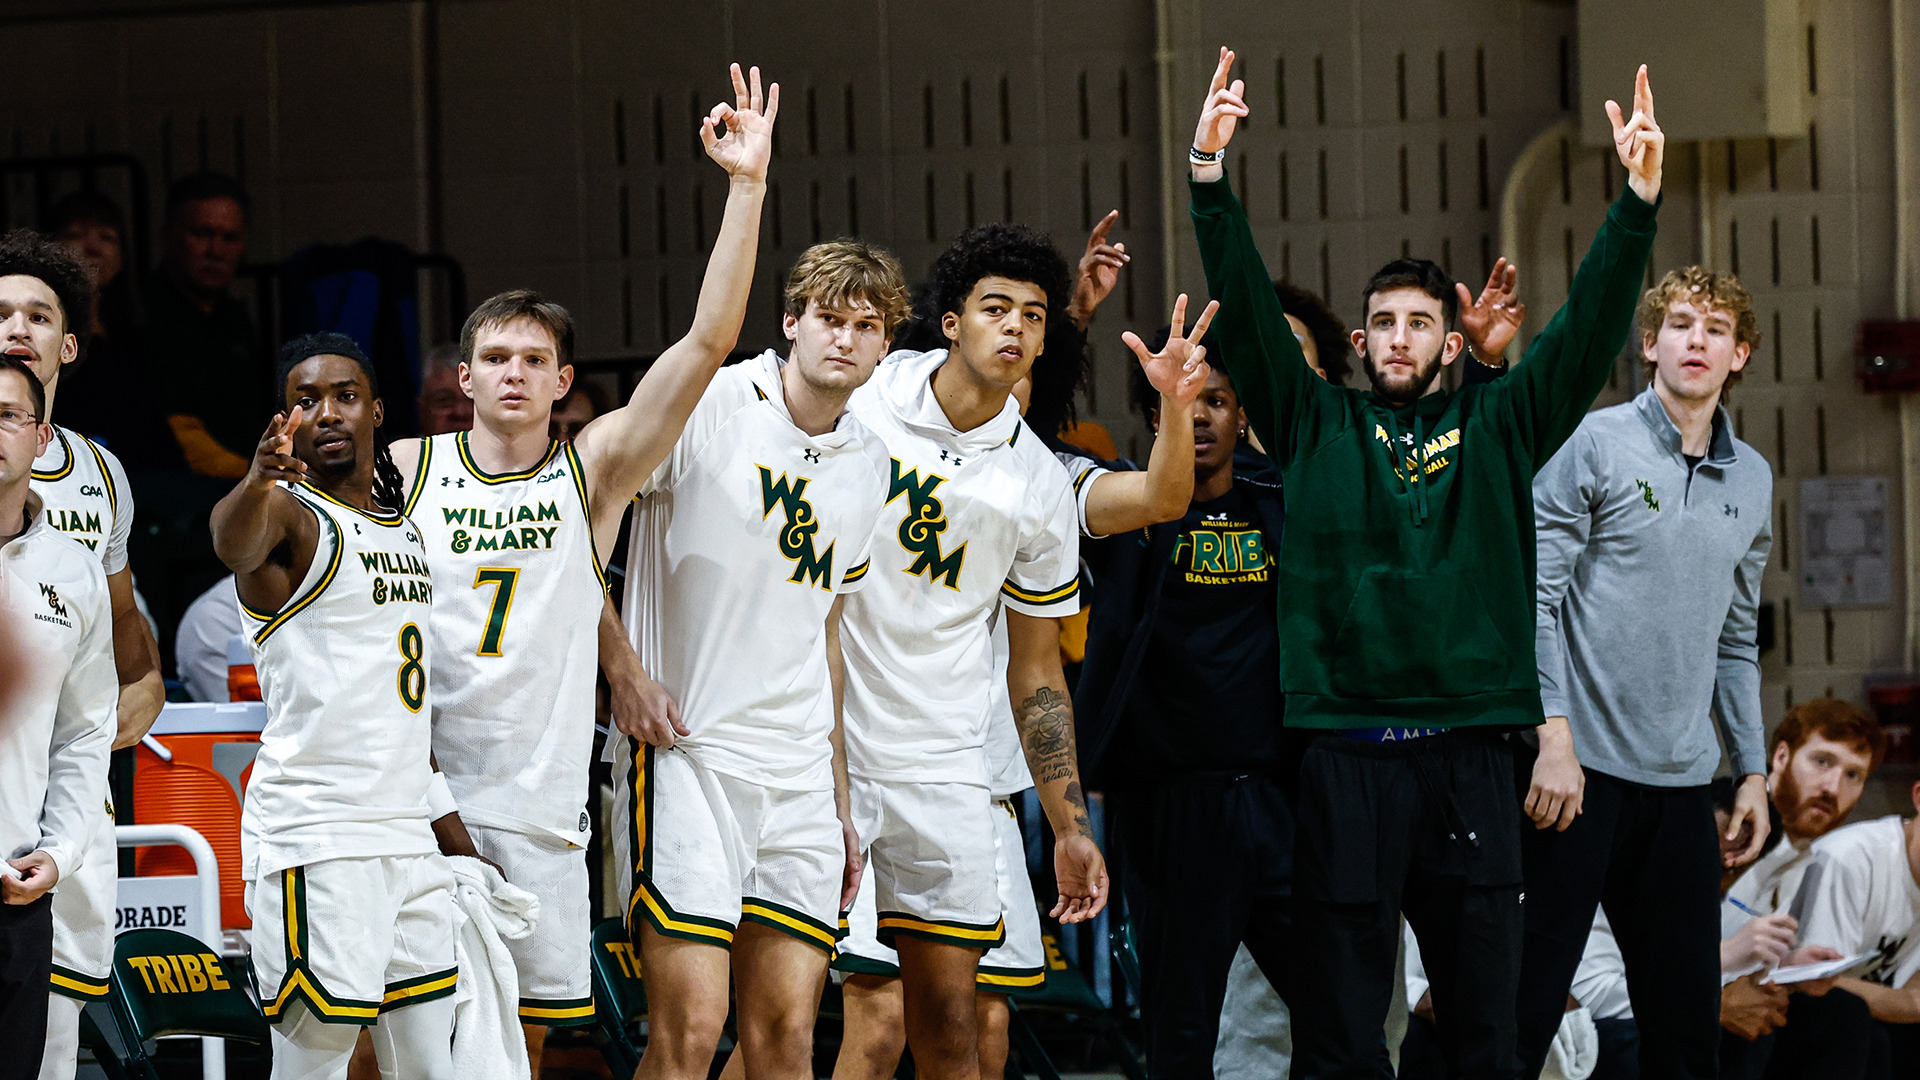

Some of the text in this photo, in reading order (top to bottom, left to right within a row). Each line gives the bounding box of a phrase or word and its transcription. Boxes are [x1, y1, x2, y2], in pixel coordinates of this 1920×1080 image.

[80, 485, 103, 498] CAA
[537, 468, 566, 485] CAA
[441, 499, 562, 530] WILLIAM
[451, 526, 558, 554] & MARY
[373, 576, 388, 606] &
[34, 613, 72, 629] BASKETBALL
[472, 566, 521, 657] 7
[397, 621, 426, 714] 8
[127, 953, 231, 994] TRIBE
